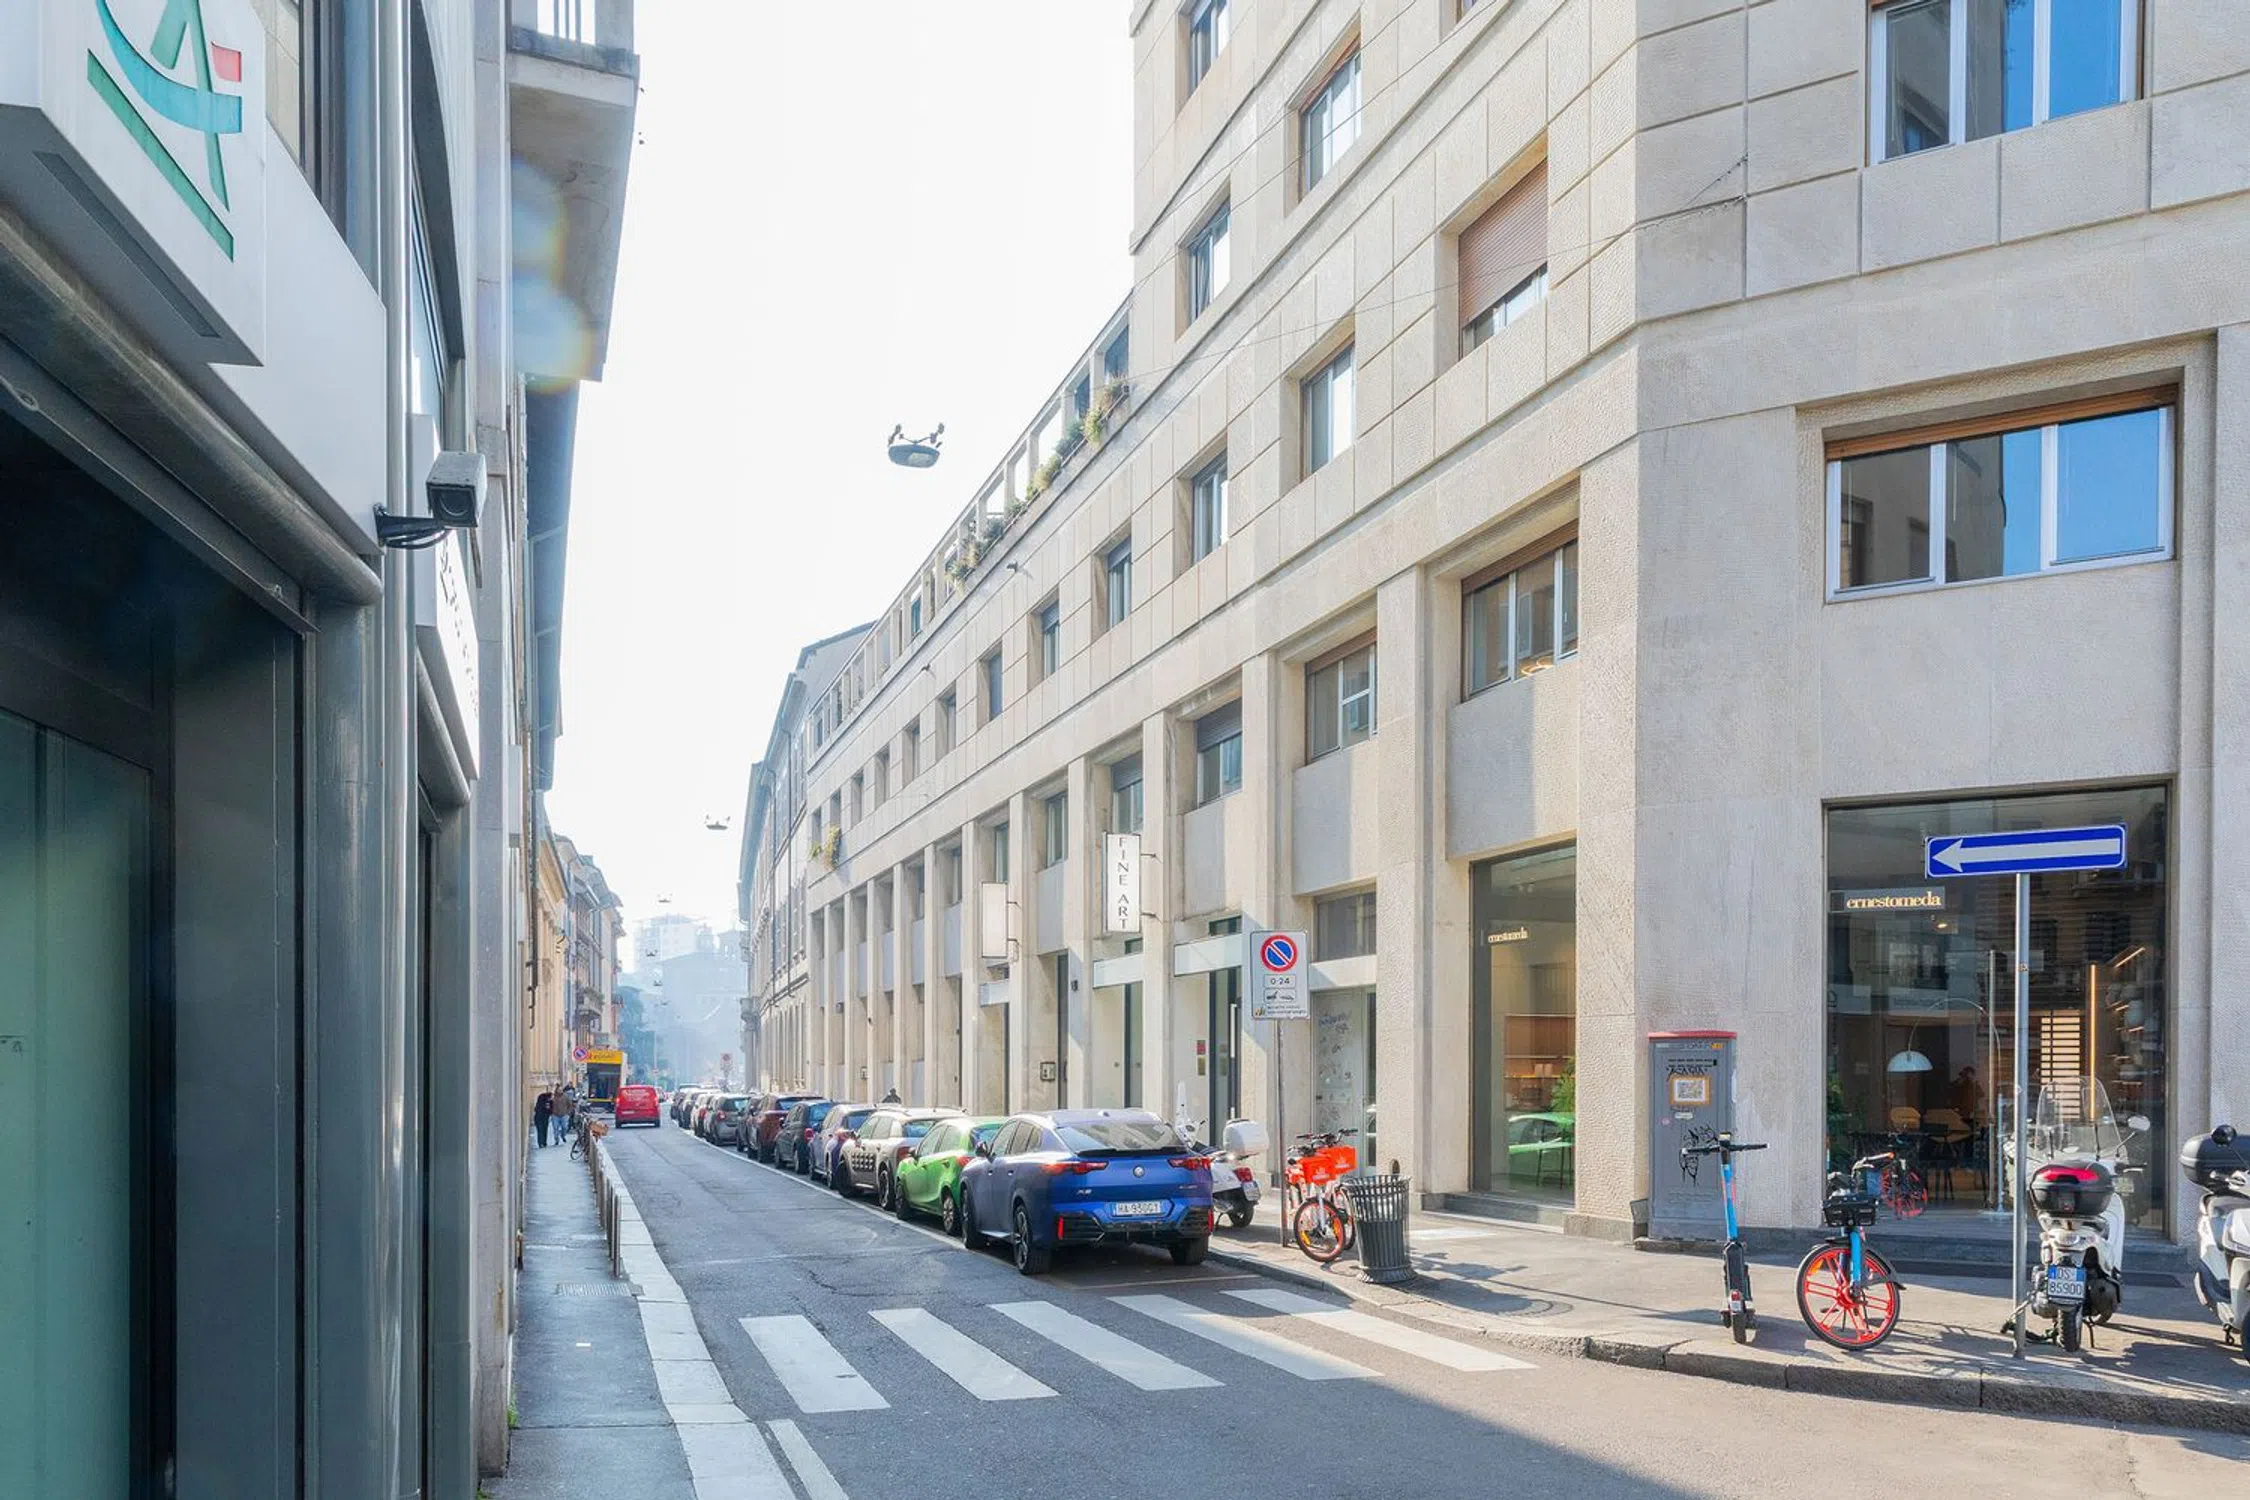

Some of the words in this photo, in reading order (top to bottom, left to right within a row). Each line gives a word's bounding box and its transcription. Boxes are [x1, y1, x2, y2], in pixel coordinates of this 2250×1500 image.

[1118, 837, 1129, 886] FINE
[1118, 893, 1129, 929] ART
[1846, 891, 1942, 909] ernestomeda
